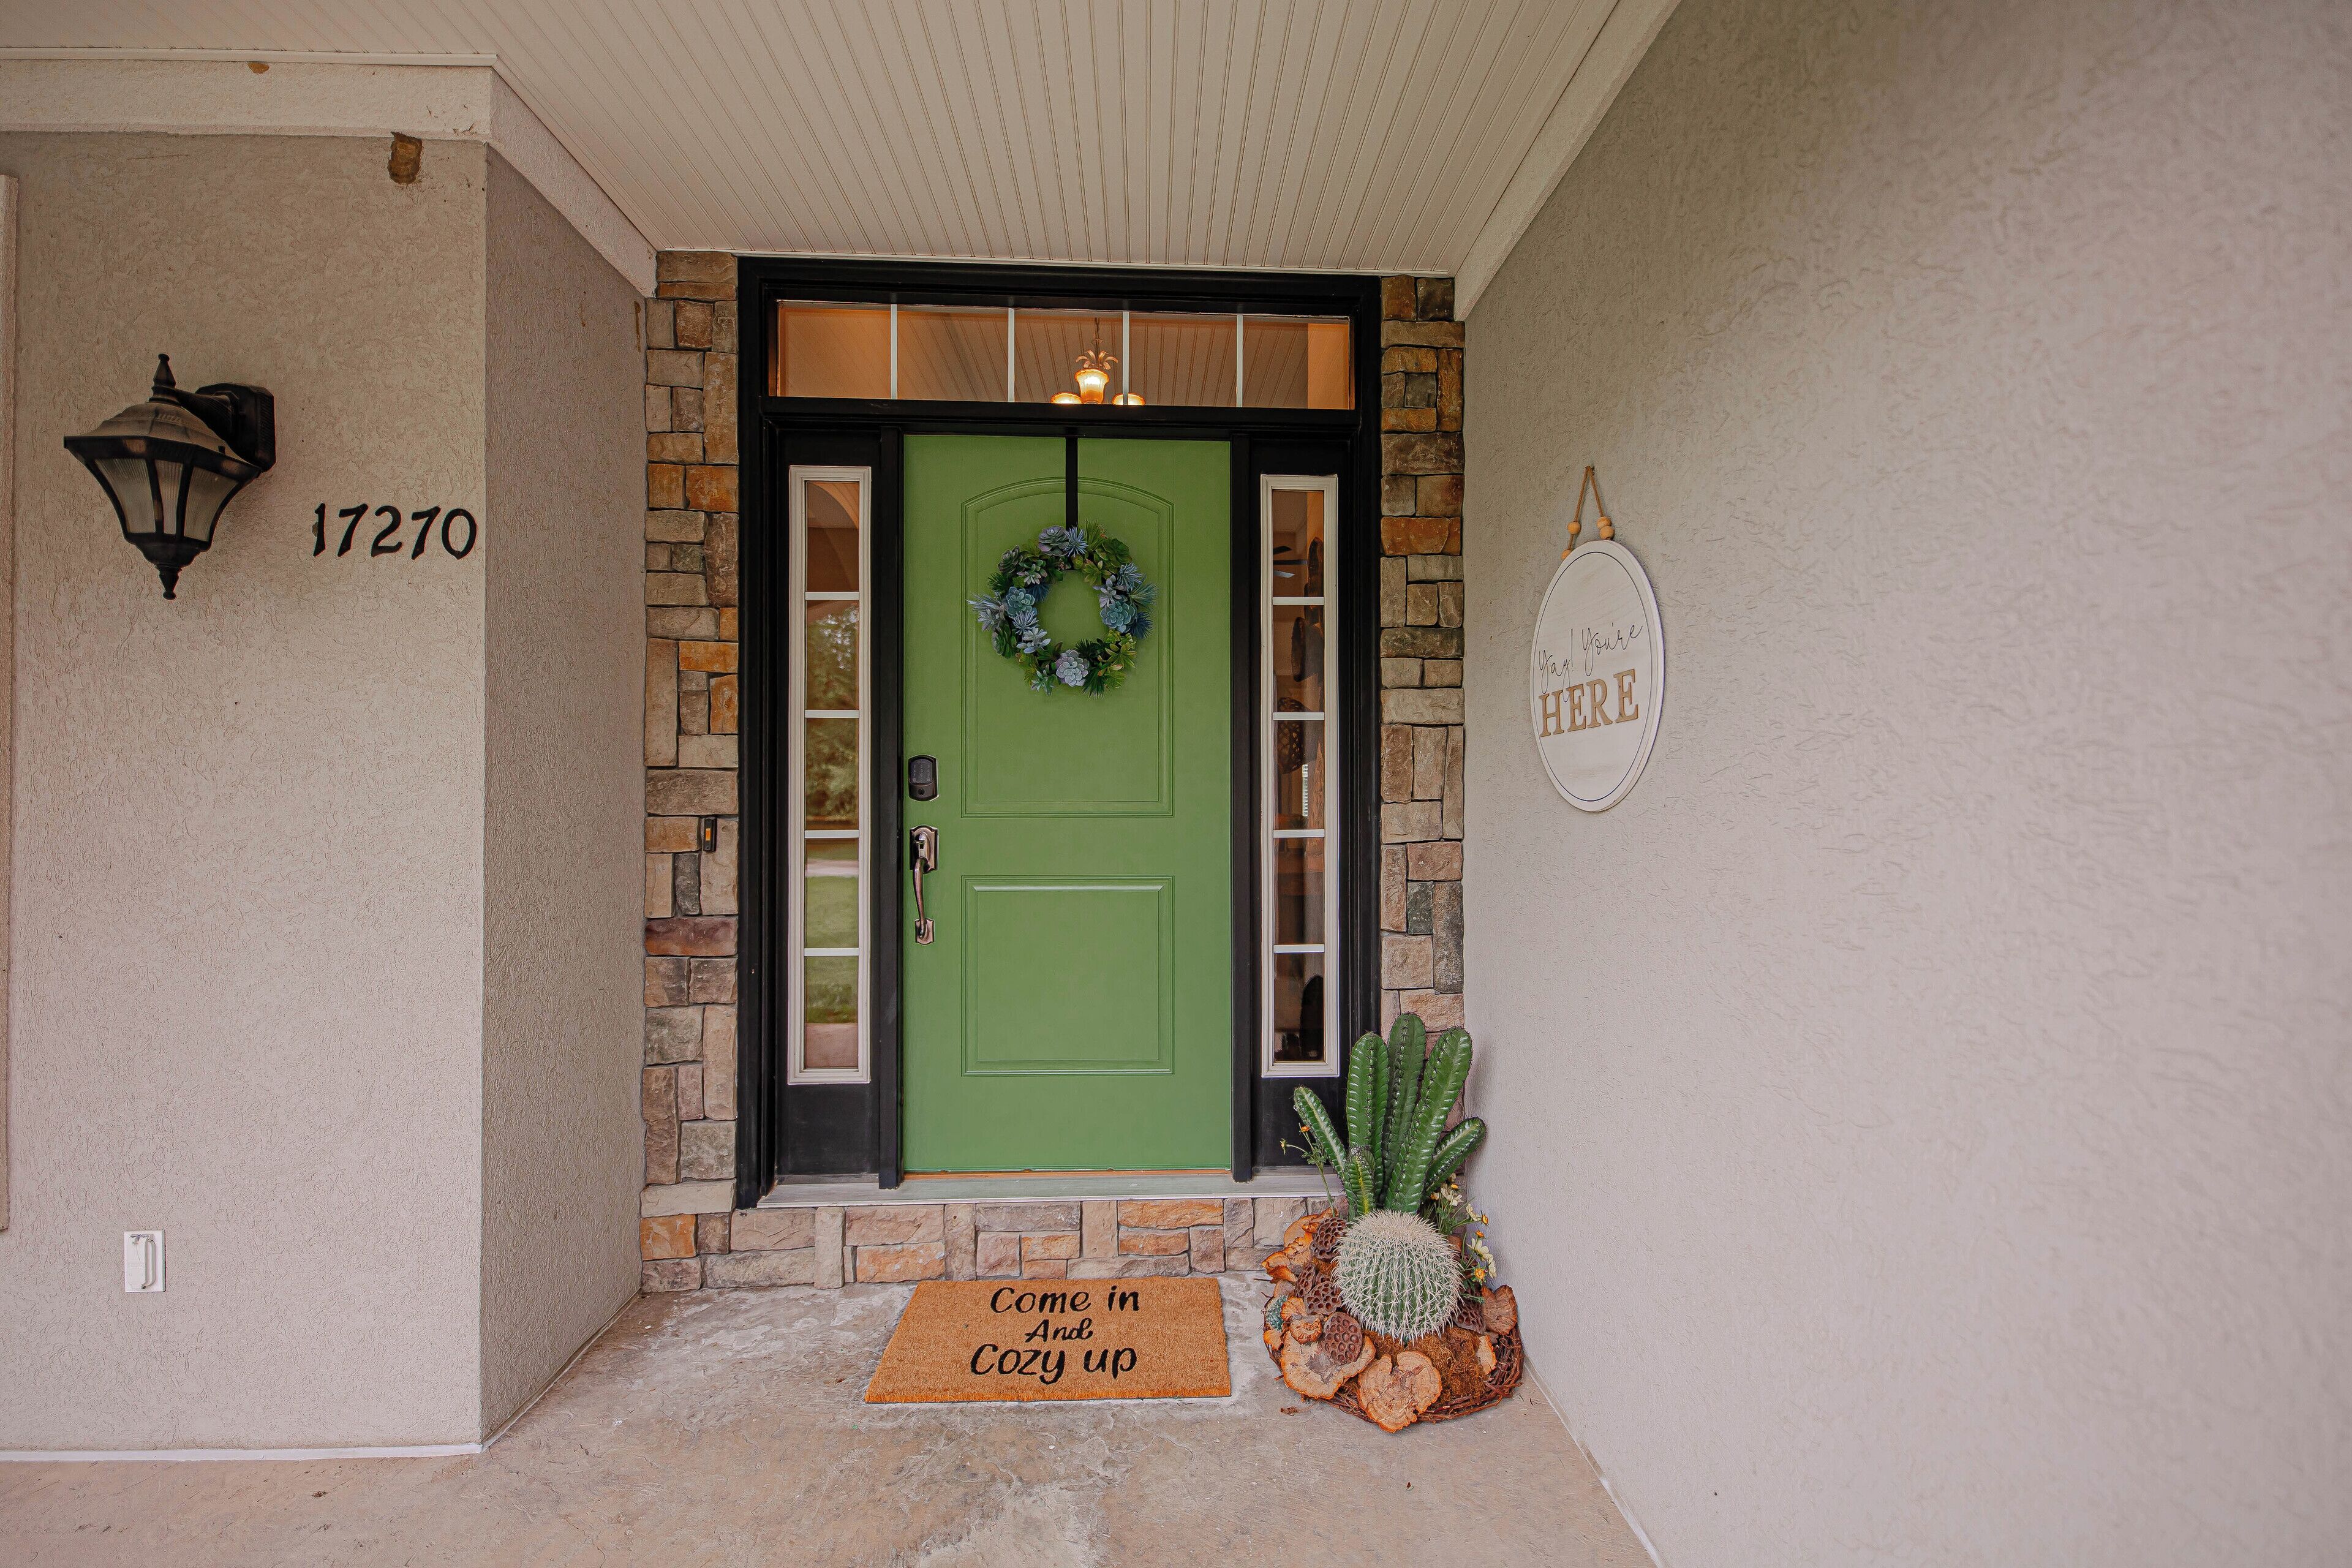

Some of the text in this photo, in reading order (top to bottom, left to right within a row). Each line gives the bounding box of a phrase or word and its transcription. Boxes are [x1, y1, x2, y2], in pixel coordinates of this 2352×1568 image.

[313, 503, 477, 560] 17270
[1539, 622, 1643, 703] Yay! You're
[1538, 668, 1638, 737] HERE
[990, 1285, 1139, 1313] Come in
[1025, 1317, 1093, 1343] And
[970, 1343, 1137, 1385] Cozy up
